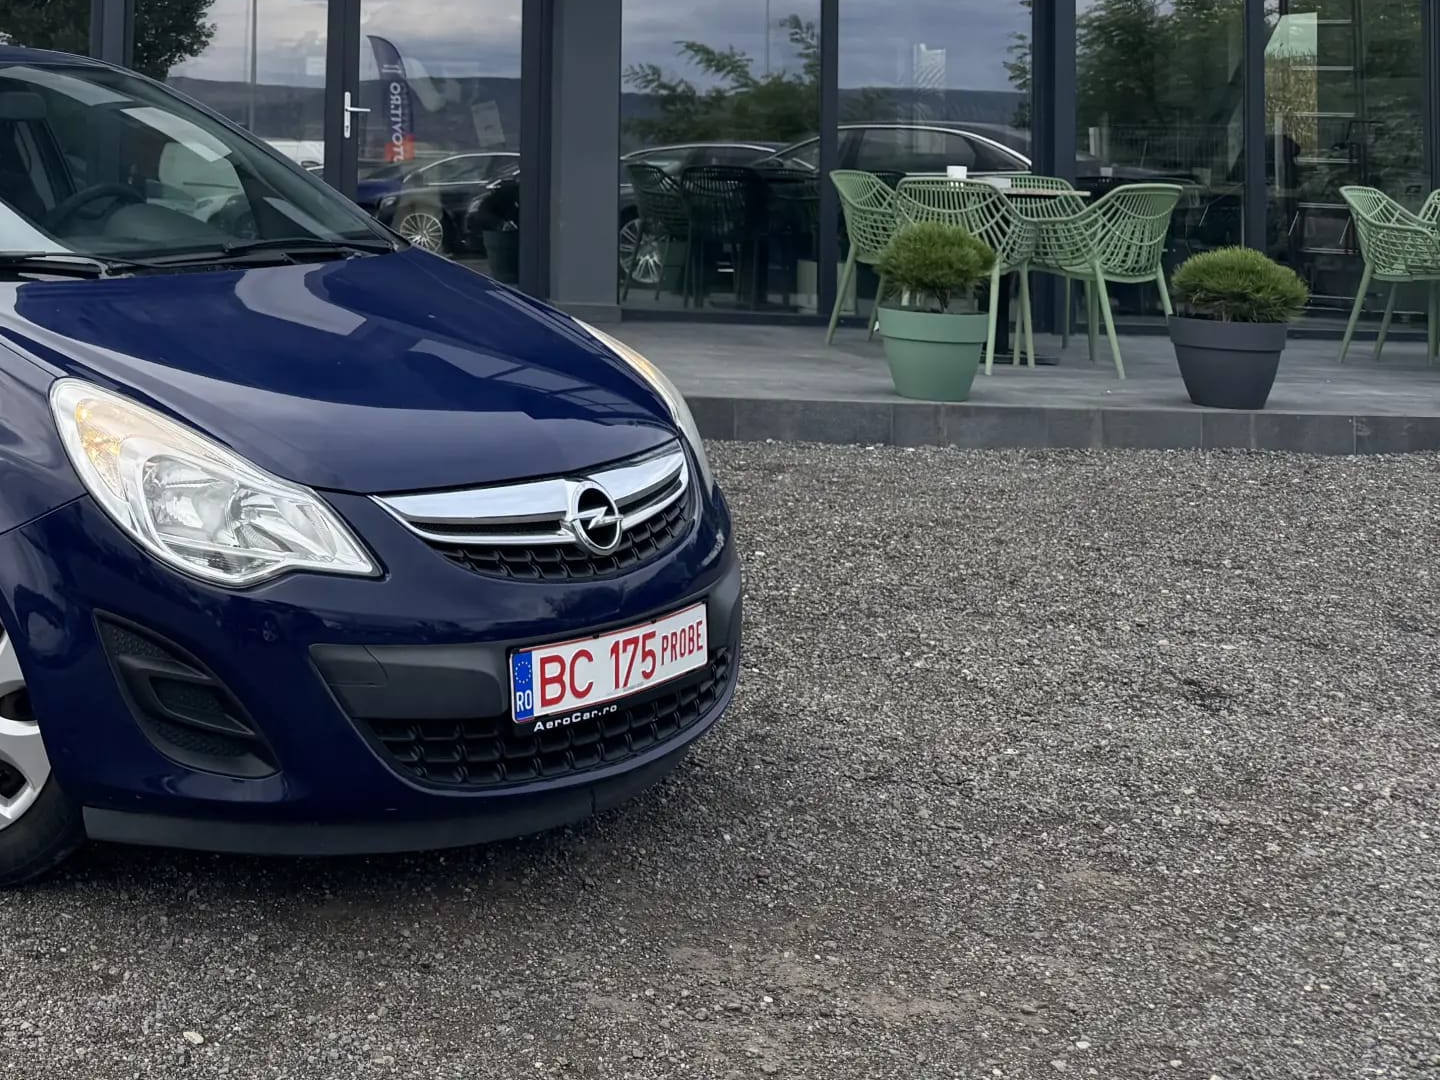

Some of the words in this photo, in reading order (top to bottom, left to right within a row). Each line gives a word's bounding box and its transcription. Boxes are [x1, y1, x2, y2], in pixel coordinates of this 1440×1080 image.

[539, 649, 594, 708] BC
[610, 631, 657, 690] 175
[661, 620, 704, 666] PROBE
[516, 689, 533, 713] RO
[533, 704, 618, 733] AeroCar.ro
